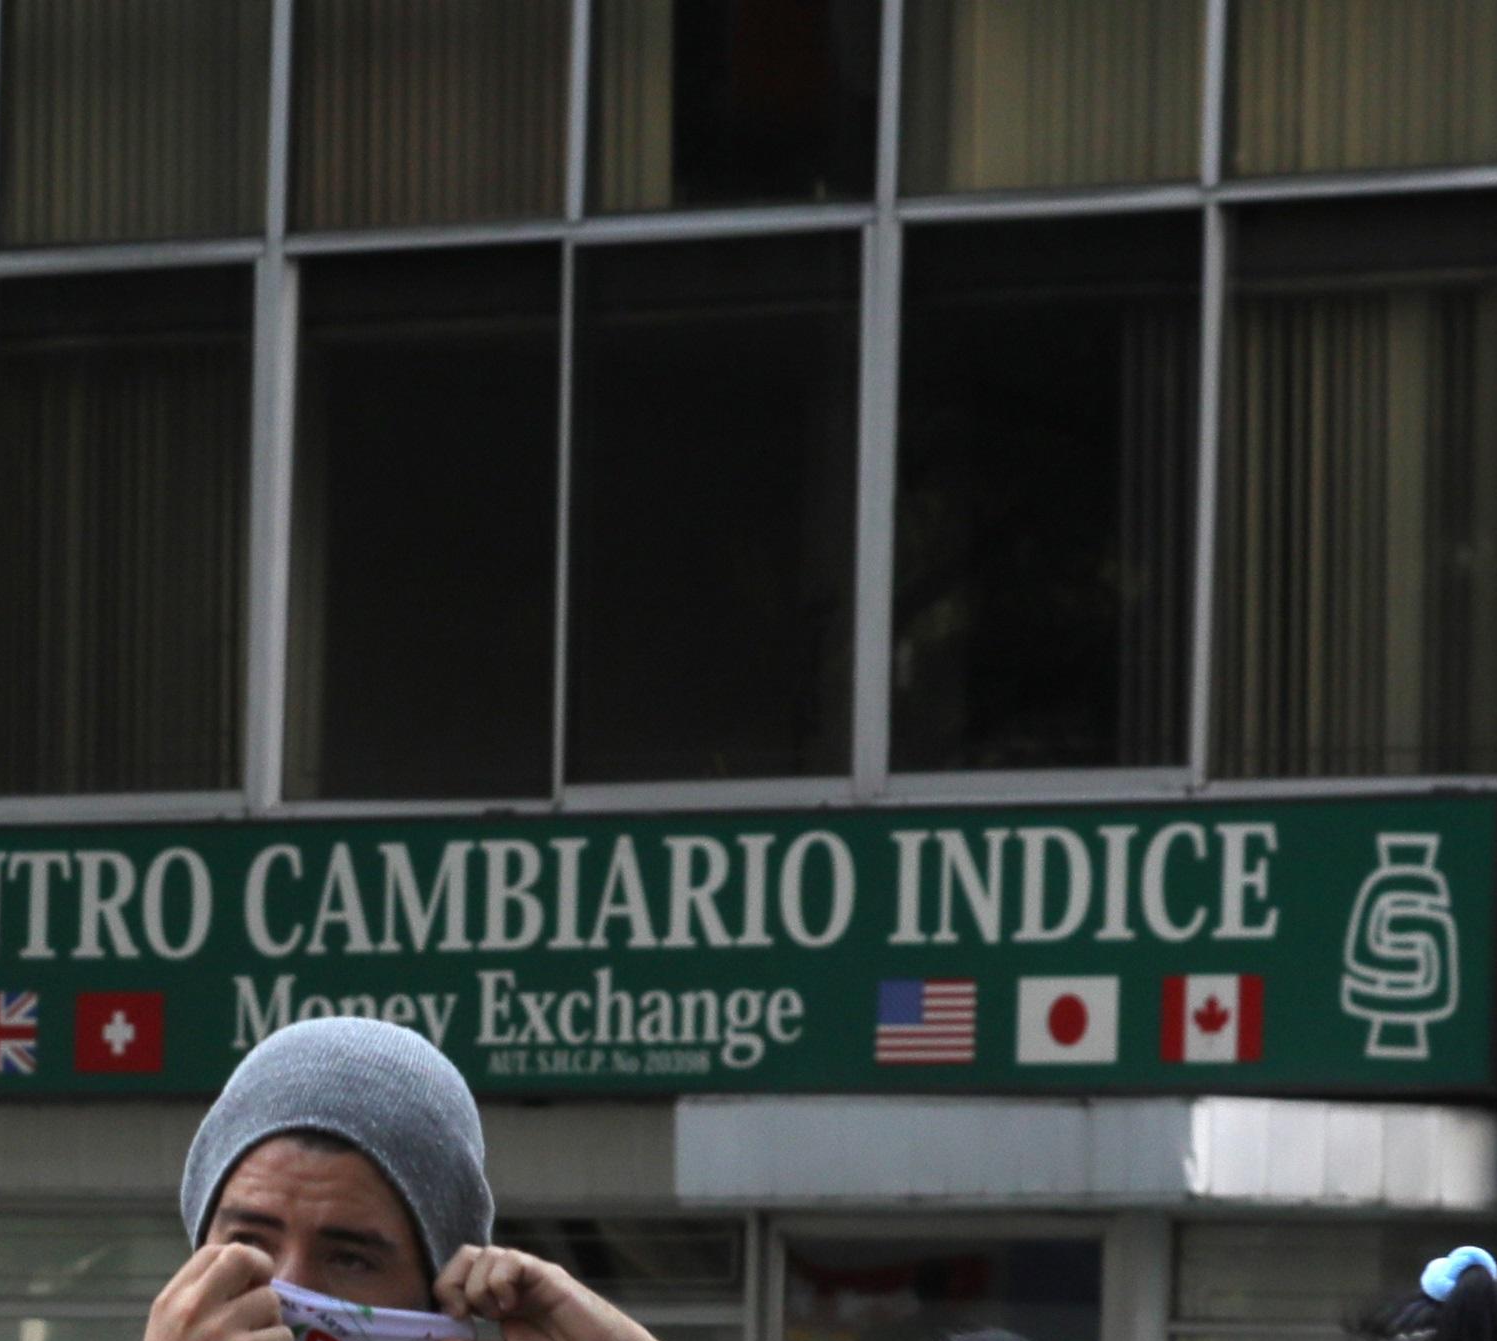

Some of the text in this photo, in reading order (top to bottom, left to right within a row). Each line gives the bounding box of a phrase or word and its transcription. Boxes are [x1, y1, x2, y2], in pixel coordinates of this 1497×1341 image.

[244, 831, 856, 957] CAMBIARIO
[887, 822, 1279, 944] INDICE
[476, 968, 804, 1068] Exchange
